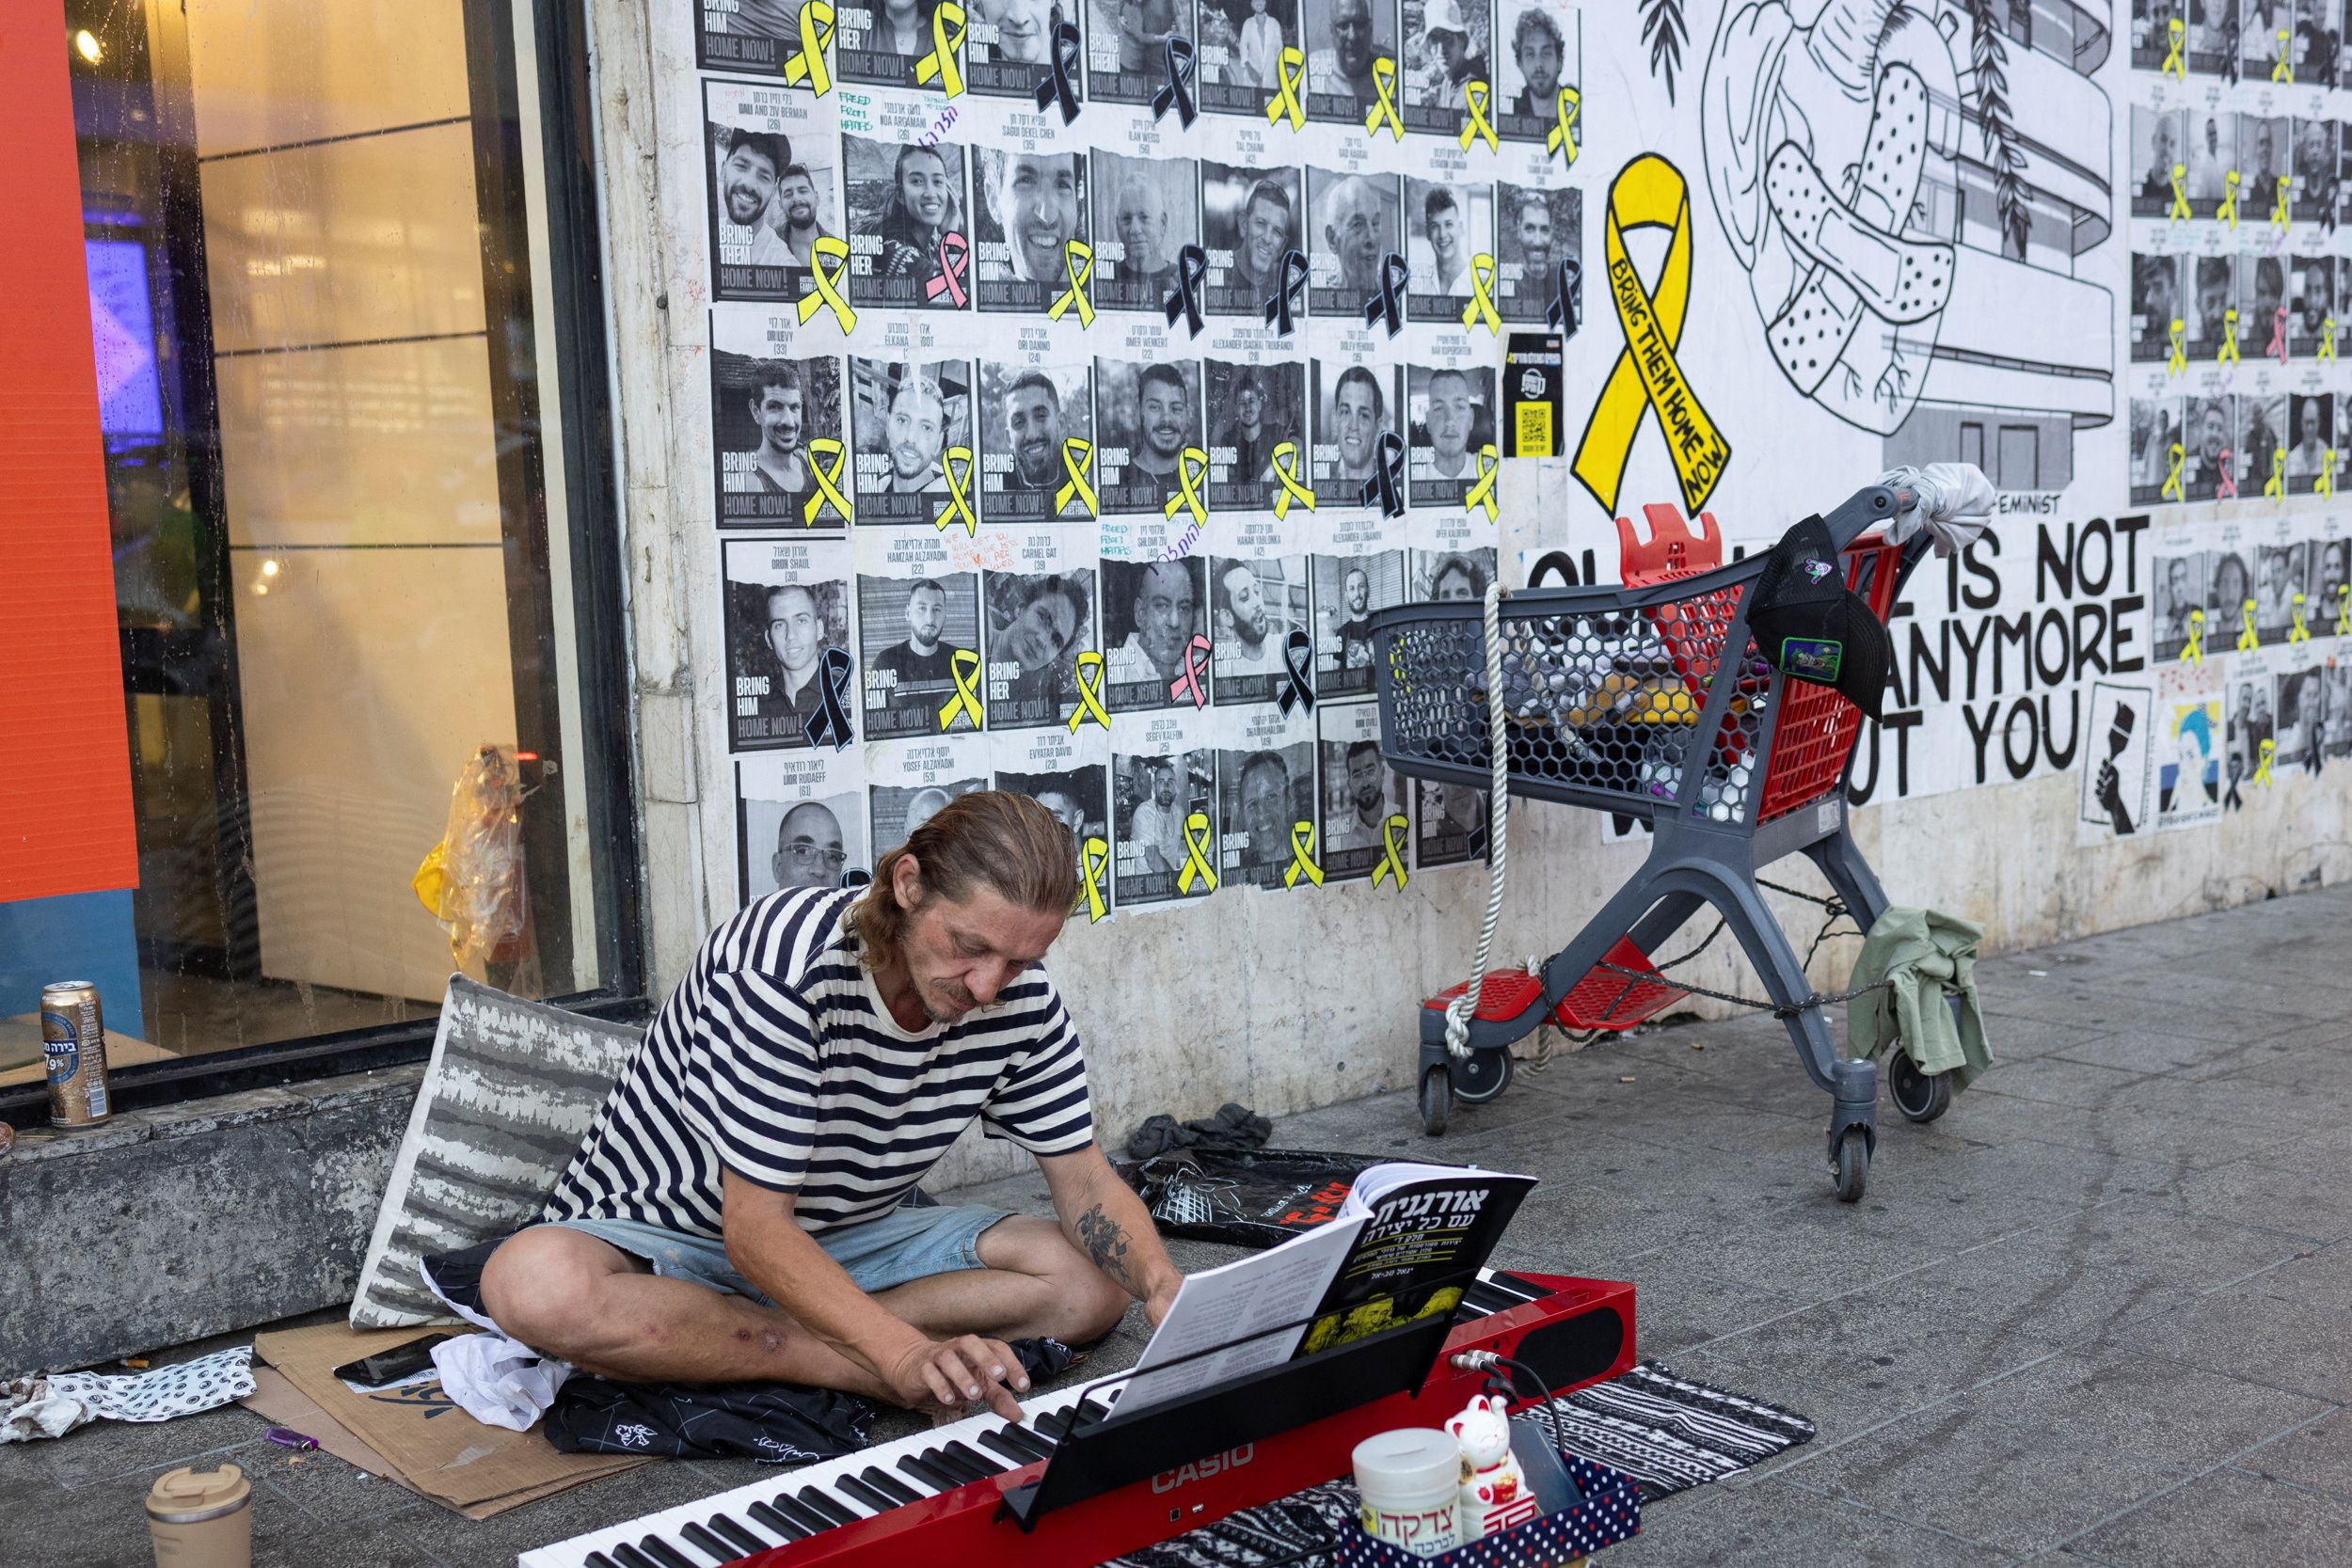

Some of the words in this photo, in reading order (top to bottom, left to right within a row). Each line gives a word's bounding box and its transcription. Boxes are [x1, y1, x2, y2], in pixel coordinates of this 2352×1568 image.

[705, 11, 727, 33] HIM
[837, 8, 871, 30] BRING
[839, 29, 860, 50] HER
[967, 23, 999, 44] BRING
[1089, 33, 1119, 53] BRING
[706, 36, 739, 58] HOME
[741, 40, 775, 62] NOW!
[968, 43, 989, 64] HIM
[1201, 45, 1229, 64] BRING
[839, 53, 870, 73] HOME
[873, 55, 905, 77] NOW!
[1201, 65, 1219, 83] HIM
[970, 65, 998, 86] HOME
[755, 104, 768, 116] AND
[770, 106, 779, 117] ZIV
[781, 108, 807, 119] BERMAN
[768, 119, 780, 131] (26)
[880, 115, 892, 126] NOA
[894, 117, 926, 128] ARGAMANI
[898, 128, 909, 141] (26)
[1041, 128, 1055, 138] CHEN
[720, 225, 753, 245] BRING
[850, 234, 882, 255] BRING
[720, 245, 752, 265] THEM
[978, 242, 1009, 261] BRING
[1096, 242, 1124, 261] BRING
[1207, 249, 1233, 268] BRING
[851, 256, 873, 275] HER
[979, 261, 999, 280] HIM
[1096, 261, 1114, 279] HIM
[721, 268, 753, 287] HOME
[755, 268, 787, 289] NOW!
[852, 278, 882, 297] HOME
[886, 277, 916, 299] NOW!
[980, 284, 1009, 302] HOME
[1011, 283, 1041, 303] NOW!
[777, 331, 793, 342] LEVY
[1029, 340, 1050, 351] DANINO
[1126, 338, 1141, 347] OMER
[773, 344, 787, 356] (33)
[1029, 353, 1041, 363] (24)
[1636, 323, 1677, 397] THEM
[1663, 387, 1705, 464] HOME
[723, 451, 757, 471] BRING
[857, 453, 888, 472] BRING
[983, 453, 1013, 472] BRING
[1101, 448, 1129, 467] BRING
[1210, 447, 1237, 464] BRING
[1313, 444, 1340, 462] BRING
[1101, 467, 1119, 485] HIM
[1211, 465, 1228, 483] HIM
[1685, 433, 1723, 503] NOW
[723, 473, 745, 492] HIM
[858, 474, 880, 492] HIM
[984, 474, 1003, 492] HIM
[724, 496, 755, 515] HOME
[759, 494, 791, 515] NOW!
[859, 497, 888, 515] HOME
[892, 494, 922, 515] NOW!
[984, 495, 1011, 513] HOME
[1102, 488, 1128, 505] HOME
[1993, 495, 2061, 514] EMiNiST
[888, 552, 912, 562] HAMZAH
[1023, 549, 1044, 559] CARMEL
[1046, 548, 1057, 558] GAT
[790, 559, 810, 569] SHAUL
[912, 563, 924, 575] (22)
[1947, 527, 2000, 612] IS
[2036, 515, 2150, 603] NOT
[785, 571, 797, 582] (30)
[1215, 642, 1242, 660] BRING
[1317, 636, 1343, 654] BRING
[1106, 647, 1135, 666] BRING
[990, 661, 1019, 681] BRING
[1107, 666, 1126, 684] HIM
[1216, 660, 1232, 677] HIM
[737, 676, 770, 696] BRING
[865, 670, 897, 688] BRING
[866, 690, 886, 709] HIM
[990, 681, 1009, 700] HER
[738, 698, 758, 716] HIM
[991, 702, 1019, 721] HOME
[738, 719, 768, 737] HOME
[771, 714, 803, 736] NOW!
[867, 711, 897, 730] HOME
[899, 705, 930, 727] NOW!
[1962, 689, 2078, 784] YOU
[1056, 747, 1072, 757] DAVID
[903, 761, 921, 772] YOSEF
[1045, 759, 1057, 769] (23)
[799, 772, 826, 784] RUDAEFF
[923, 772, 935, 783] (53)
[800, 785, 810, 797] (61)
[1326, 818, 1350, 836] BRING
[1117, 840, 1145, 859] BRING
[1222, 832, 1249, 851] BRING
[1326, 835, 1342, 852] HIM
[1118, 859, 1135, 878] HIM
[1223, 851, 1240, 868] HIM
[1371, 1189, 1489, 1228] אורגנית
[1418, 1216, 1441, 1230] כל
[1448, 1214, 1475, 1227] עם
[1362, 1221, 1412, 1244] יצירה
[1152, 1442, 1254, 1495] CASIO
[1381, 1504, 1453, 1546] צדקה
[1414, 1531, 1455, 1553] לברכה
